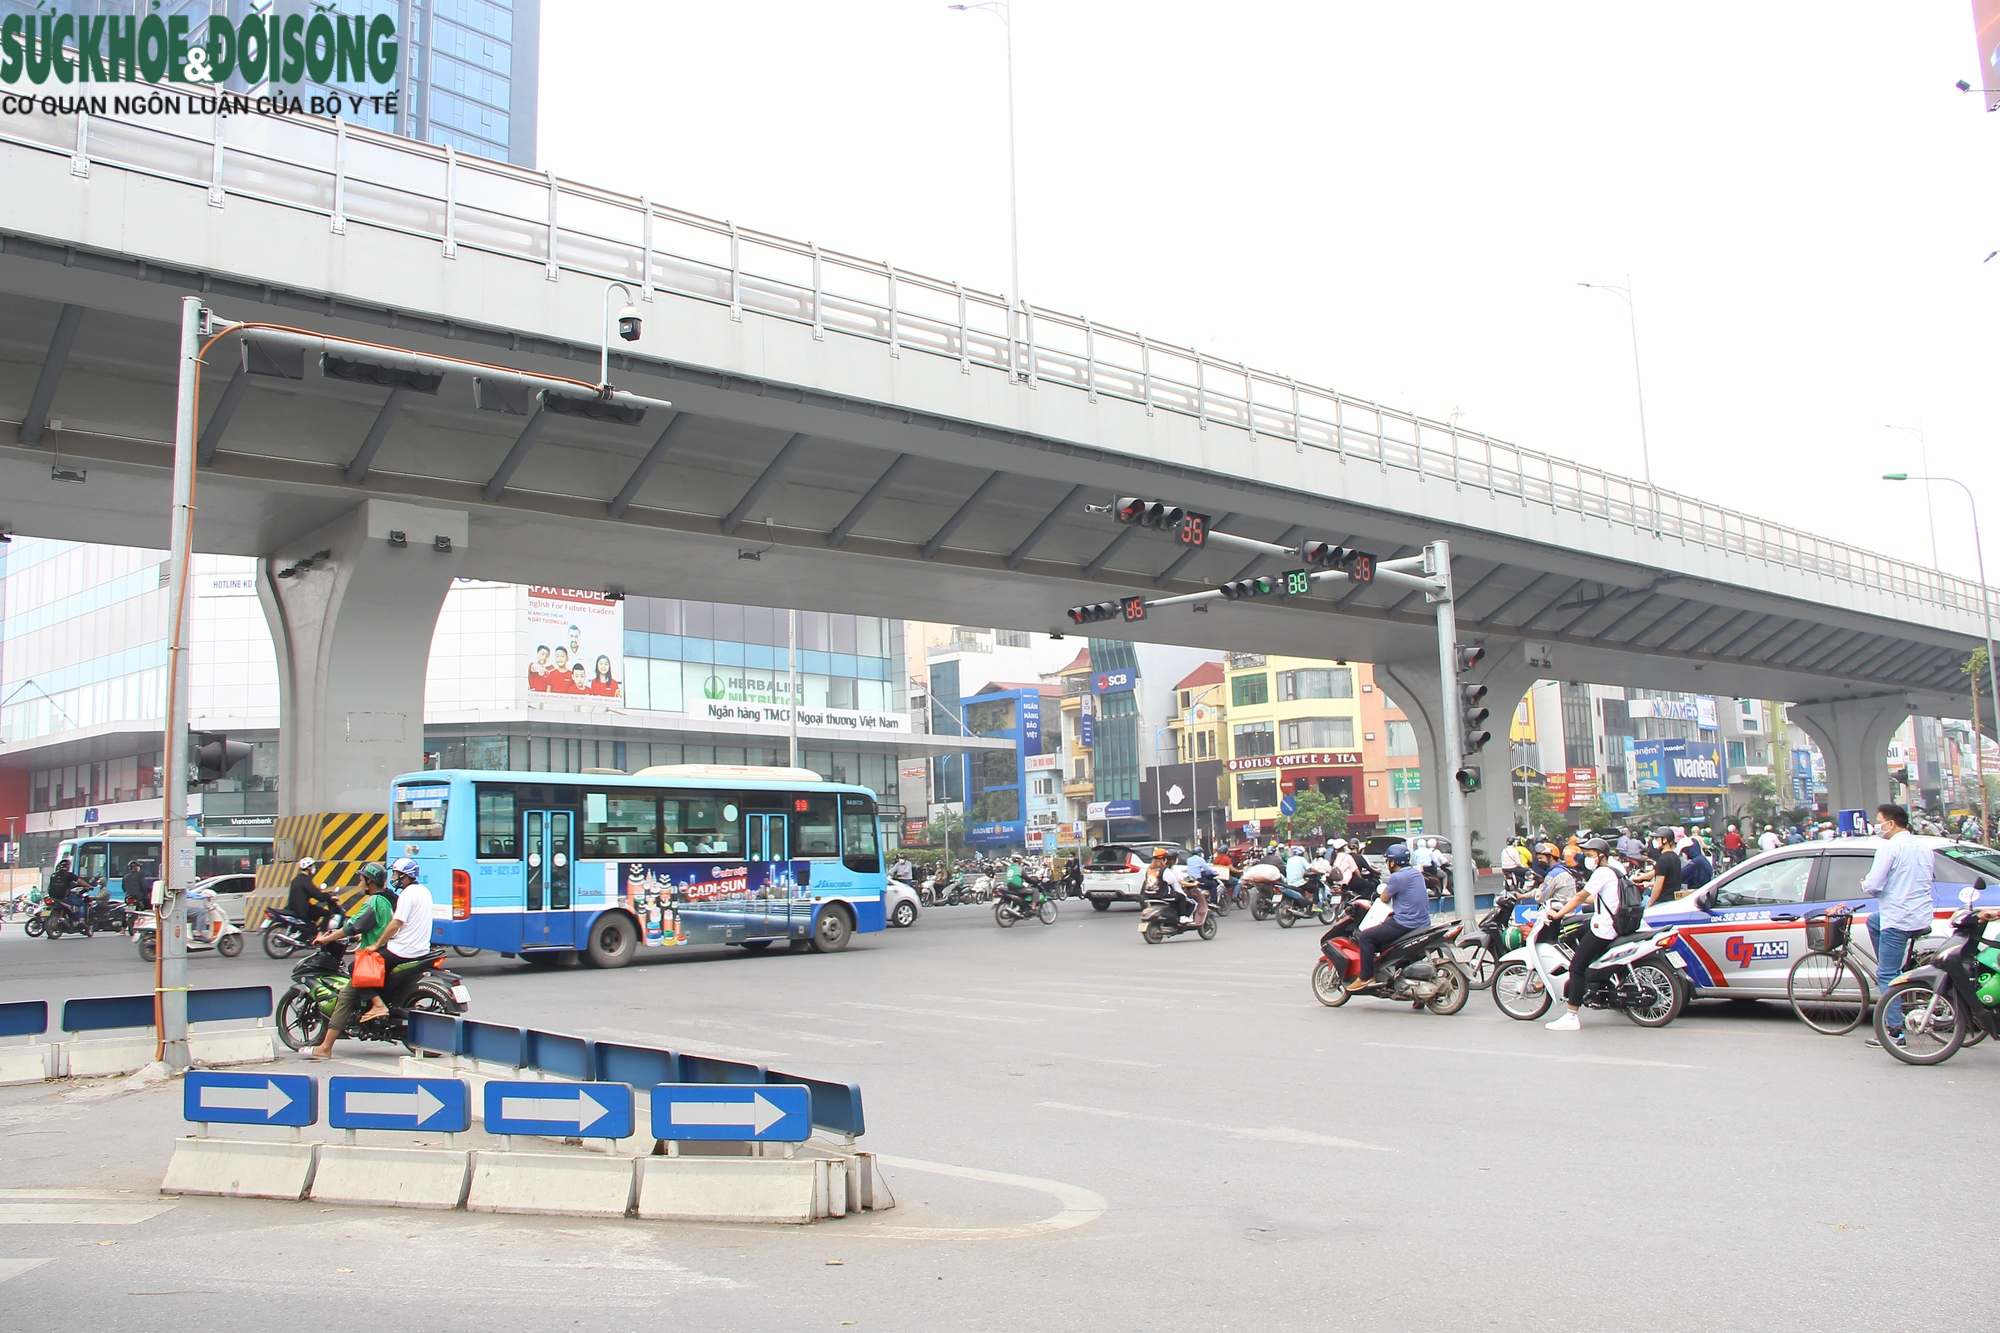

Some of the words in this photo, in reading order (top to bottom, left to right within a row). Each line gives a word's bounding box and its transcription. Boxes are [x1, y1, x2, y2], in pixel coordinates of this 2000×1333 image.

[213, 580, 241, 588] HOTLINE
[551, 602, 563, 610] For
[565, 603, 588, 612] Future
[588, 606, 615, 616] Leaders
[1108, 674, 1127, 686] SCB
[1023, 702, 1038, 710] NGÂN
[708, 704, 734, 719] Ngân
[737, 706, 760, 722] hàng
[797, 711, 823, 726] Ngoại
[826, 713, 857, 729] thương
[859, 715, 877, 729] Việt
[879, 717, 899, 728] Nam
[1239, 757, 1271, 769] LOTUS
[1323, 754, 1331, 763] &
[1336, 753, 1357, 763] TEA
[688, 879, 747, 898] CADI-SUN
[1723, 913, 1734, 921] 32
[1735, 912, 1746, 920] 32
[1747, 911, 1758, 920] 32
[1759, 911, 1770, 919] 32
[1726, 936, 1754, 968] G7
[1753, 942, 1788, 955] TAXI
